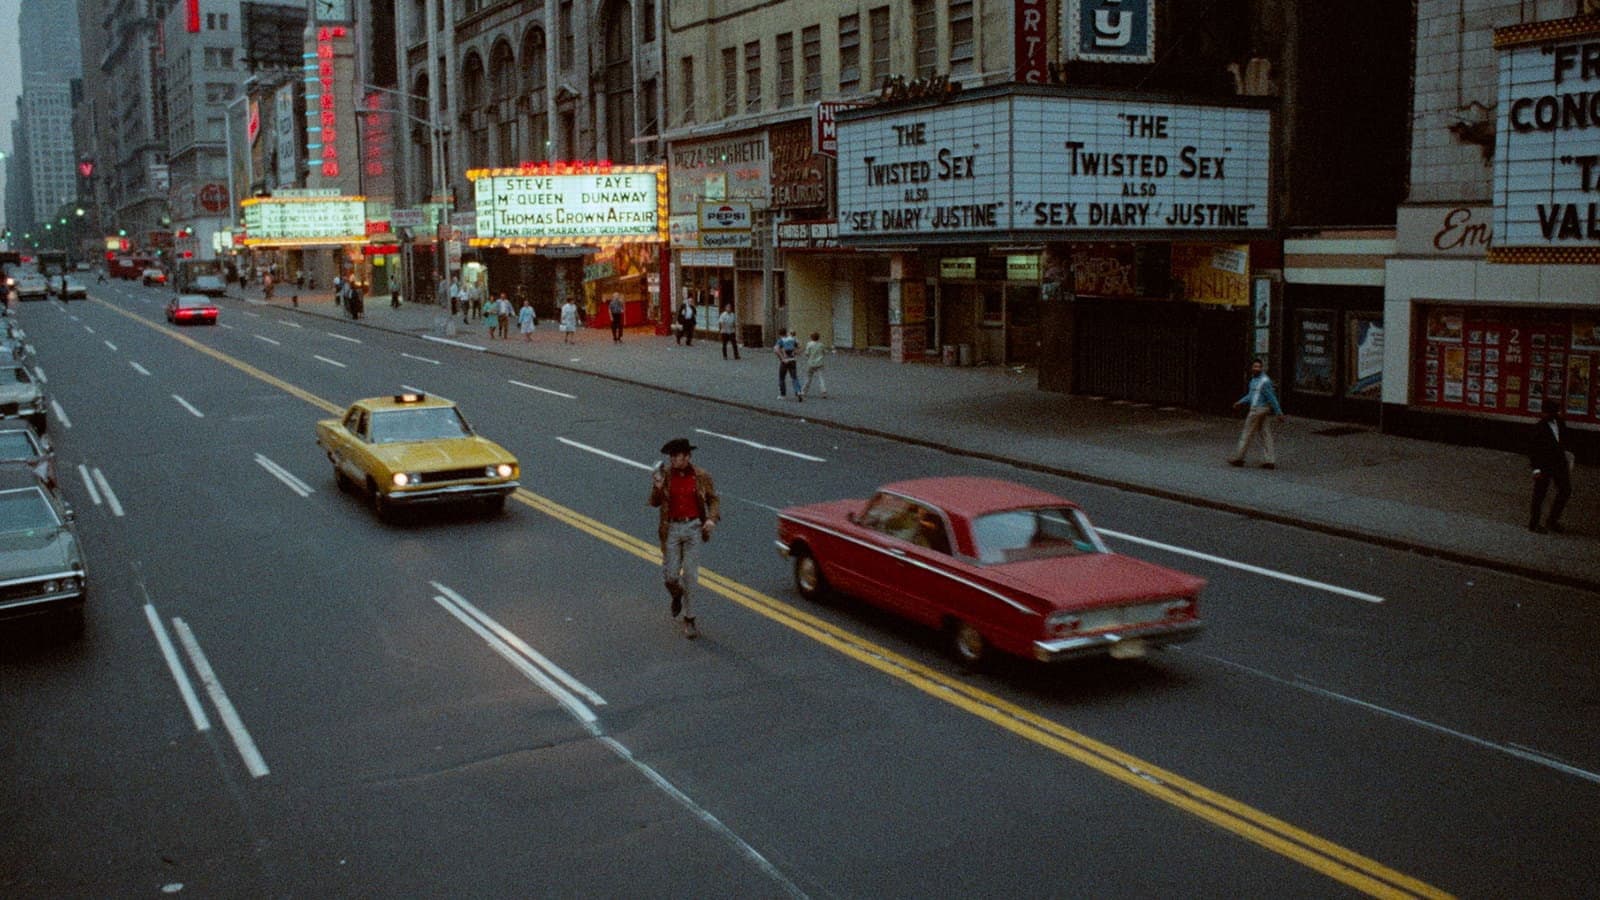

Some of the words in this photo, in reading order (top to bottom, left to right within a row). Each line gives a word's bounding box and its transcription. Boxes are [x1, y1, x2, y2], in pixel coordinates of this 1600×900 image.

[1066, 141, 1168, 177] TWISTED
[864, 155, 931, 187] TWISTED
[506, 178, 553, 191] STEVE
[596, 176, 632, 189] FAYE
[1121, 182, 1157, 197] ALSO
[581, 191, 648, 205] DUNAWAY
[707, 213, 746, 221] PEPSI
[1088, 202, 1151, 226] DIARY
